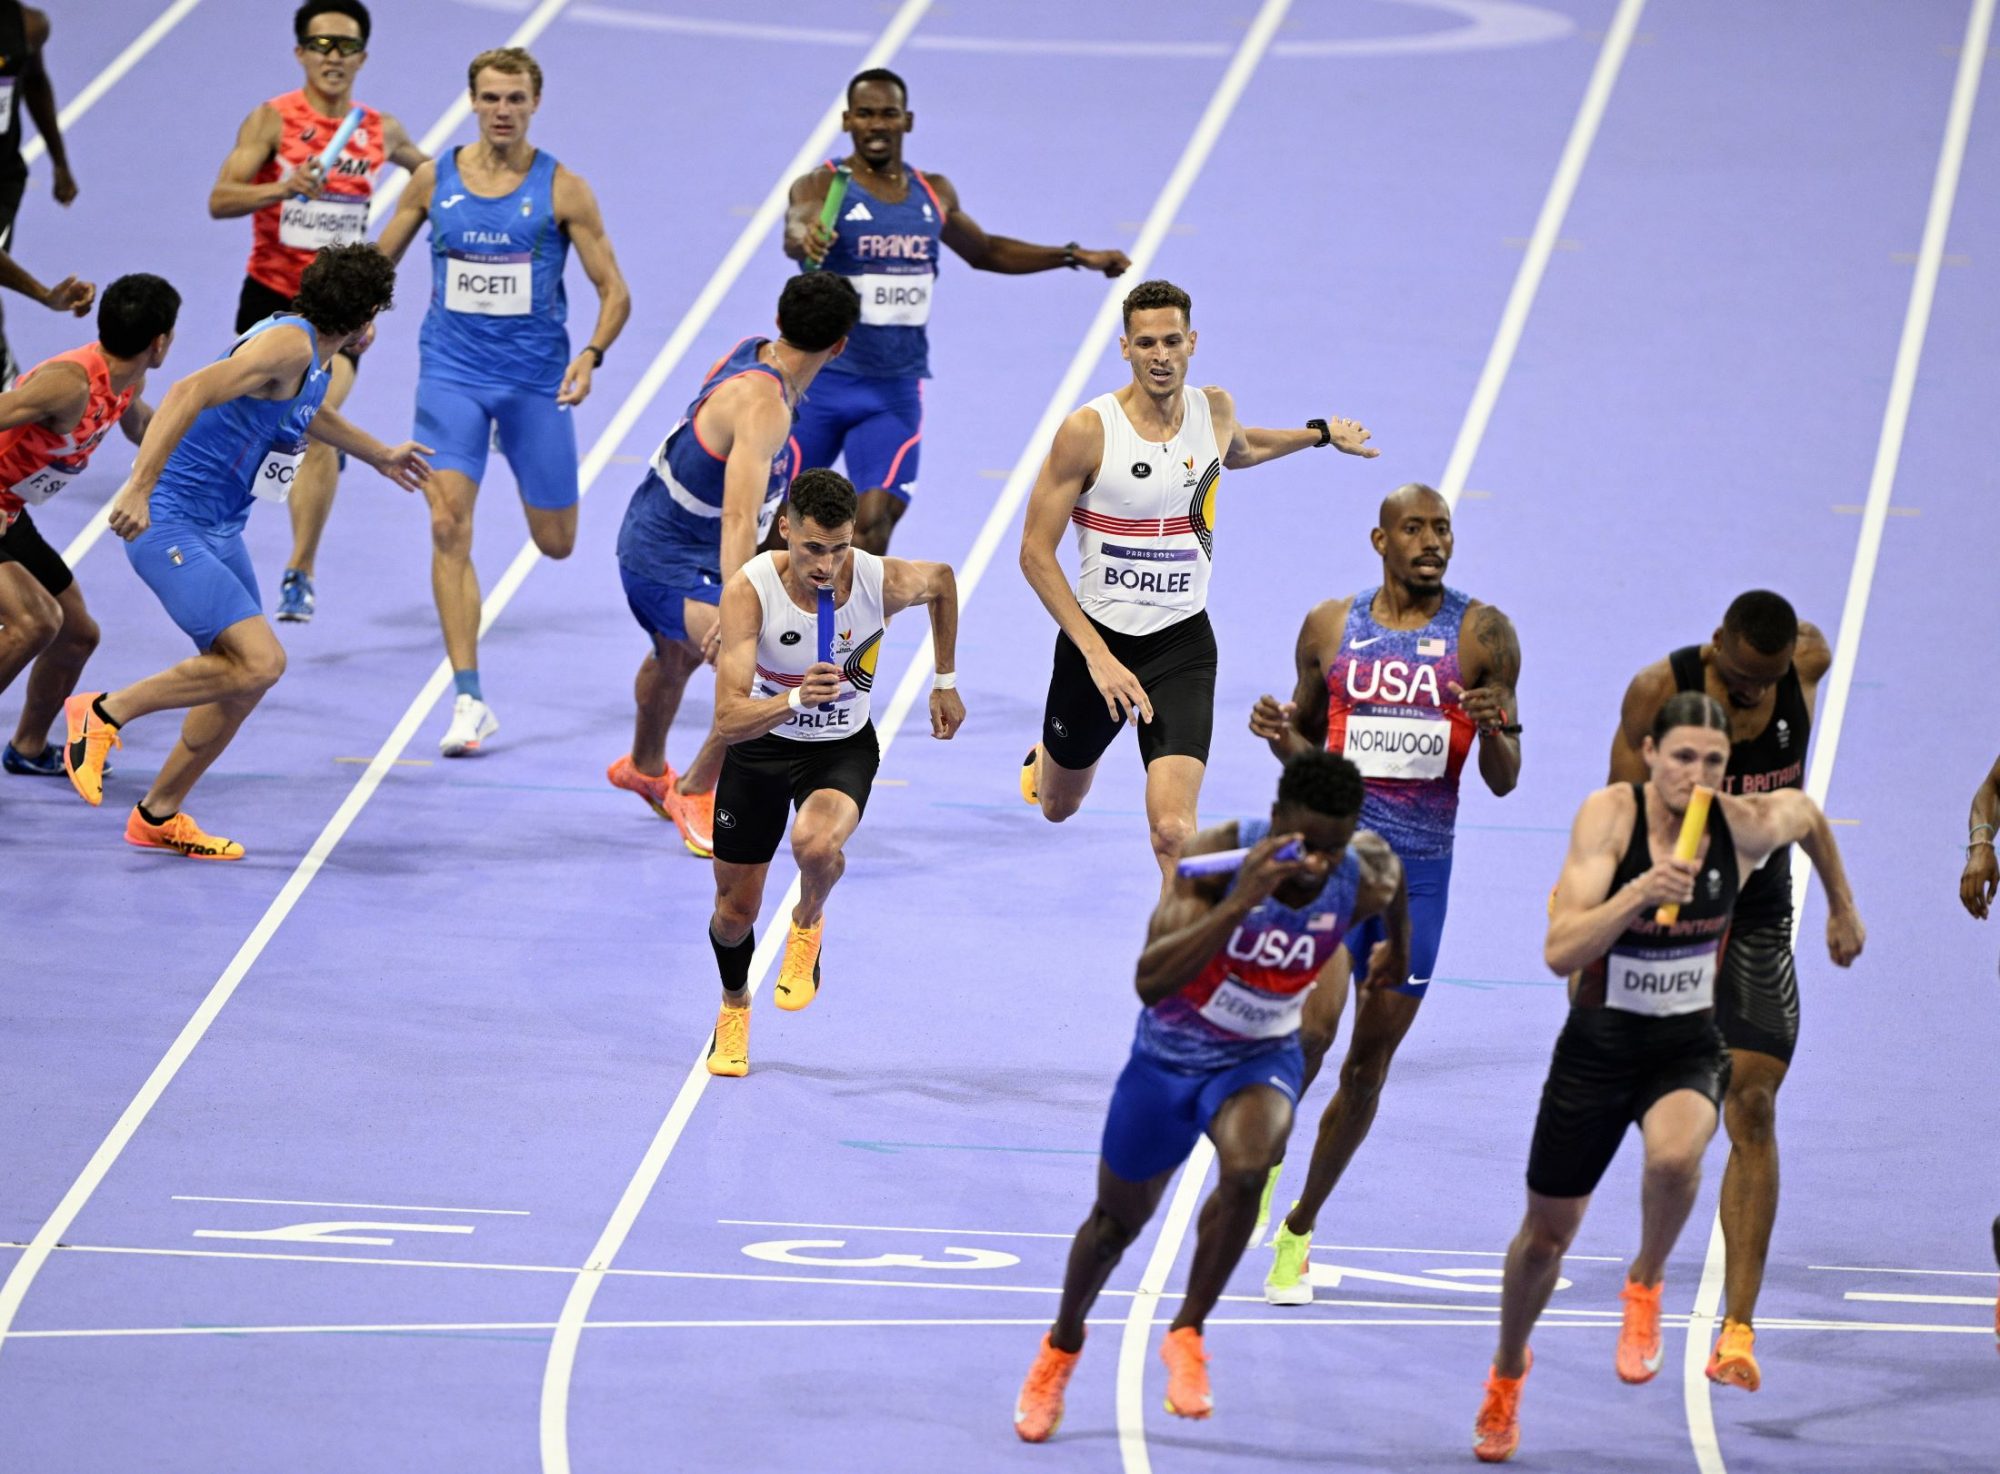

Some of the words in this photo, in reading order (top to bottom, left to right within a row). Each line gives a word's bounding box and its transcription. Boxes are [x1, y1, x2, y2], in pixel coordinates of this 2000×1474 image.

[463, 231, 511, 244] ITALIA
[858, 234, 931, 259] FRANCE
[458, 273, 517, 294] ACETI
[1126, 550, 1150, 558] PARIS
[1153, 551, 1175, 559] 2024
[1105, 566, 1191, 593] BORLEE
[1346, 659, 1440, 706] USA
[783, 708, 850, 729] ORLEE
[1349, 730, 1445, 756] NORWOOD
[1227, 926, 1315, 970] USA
[1624, 968, 1703, 994] DAVEY
[740, 1239, 1021, 1270] 3
